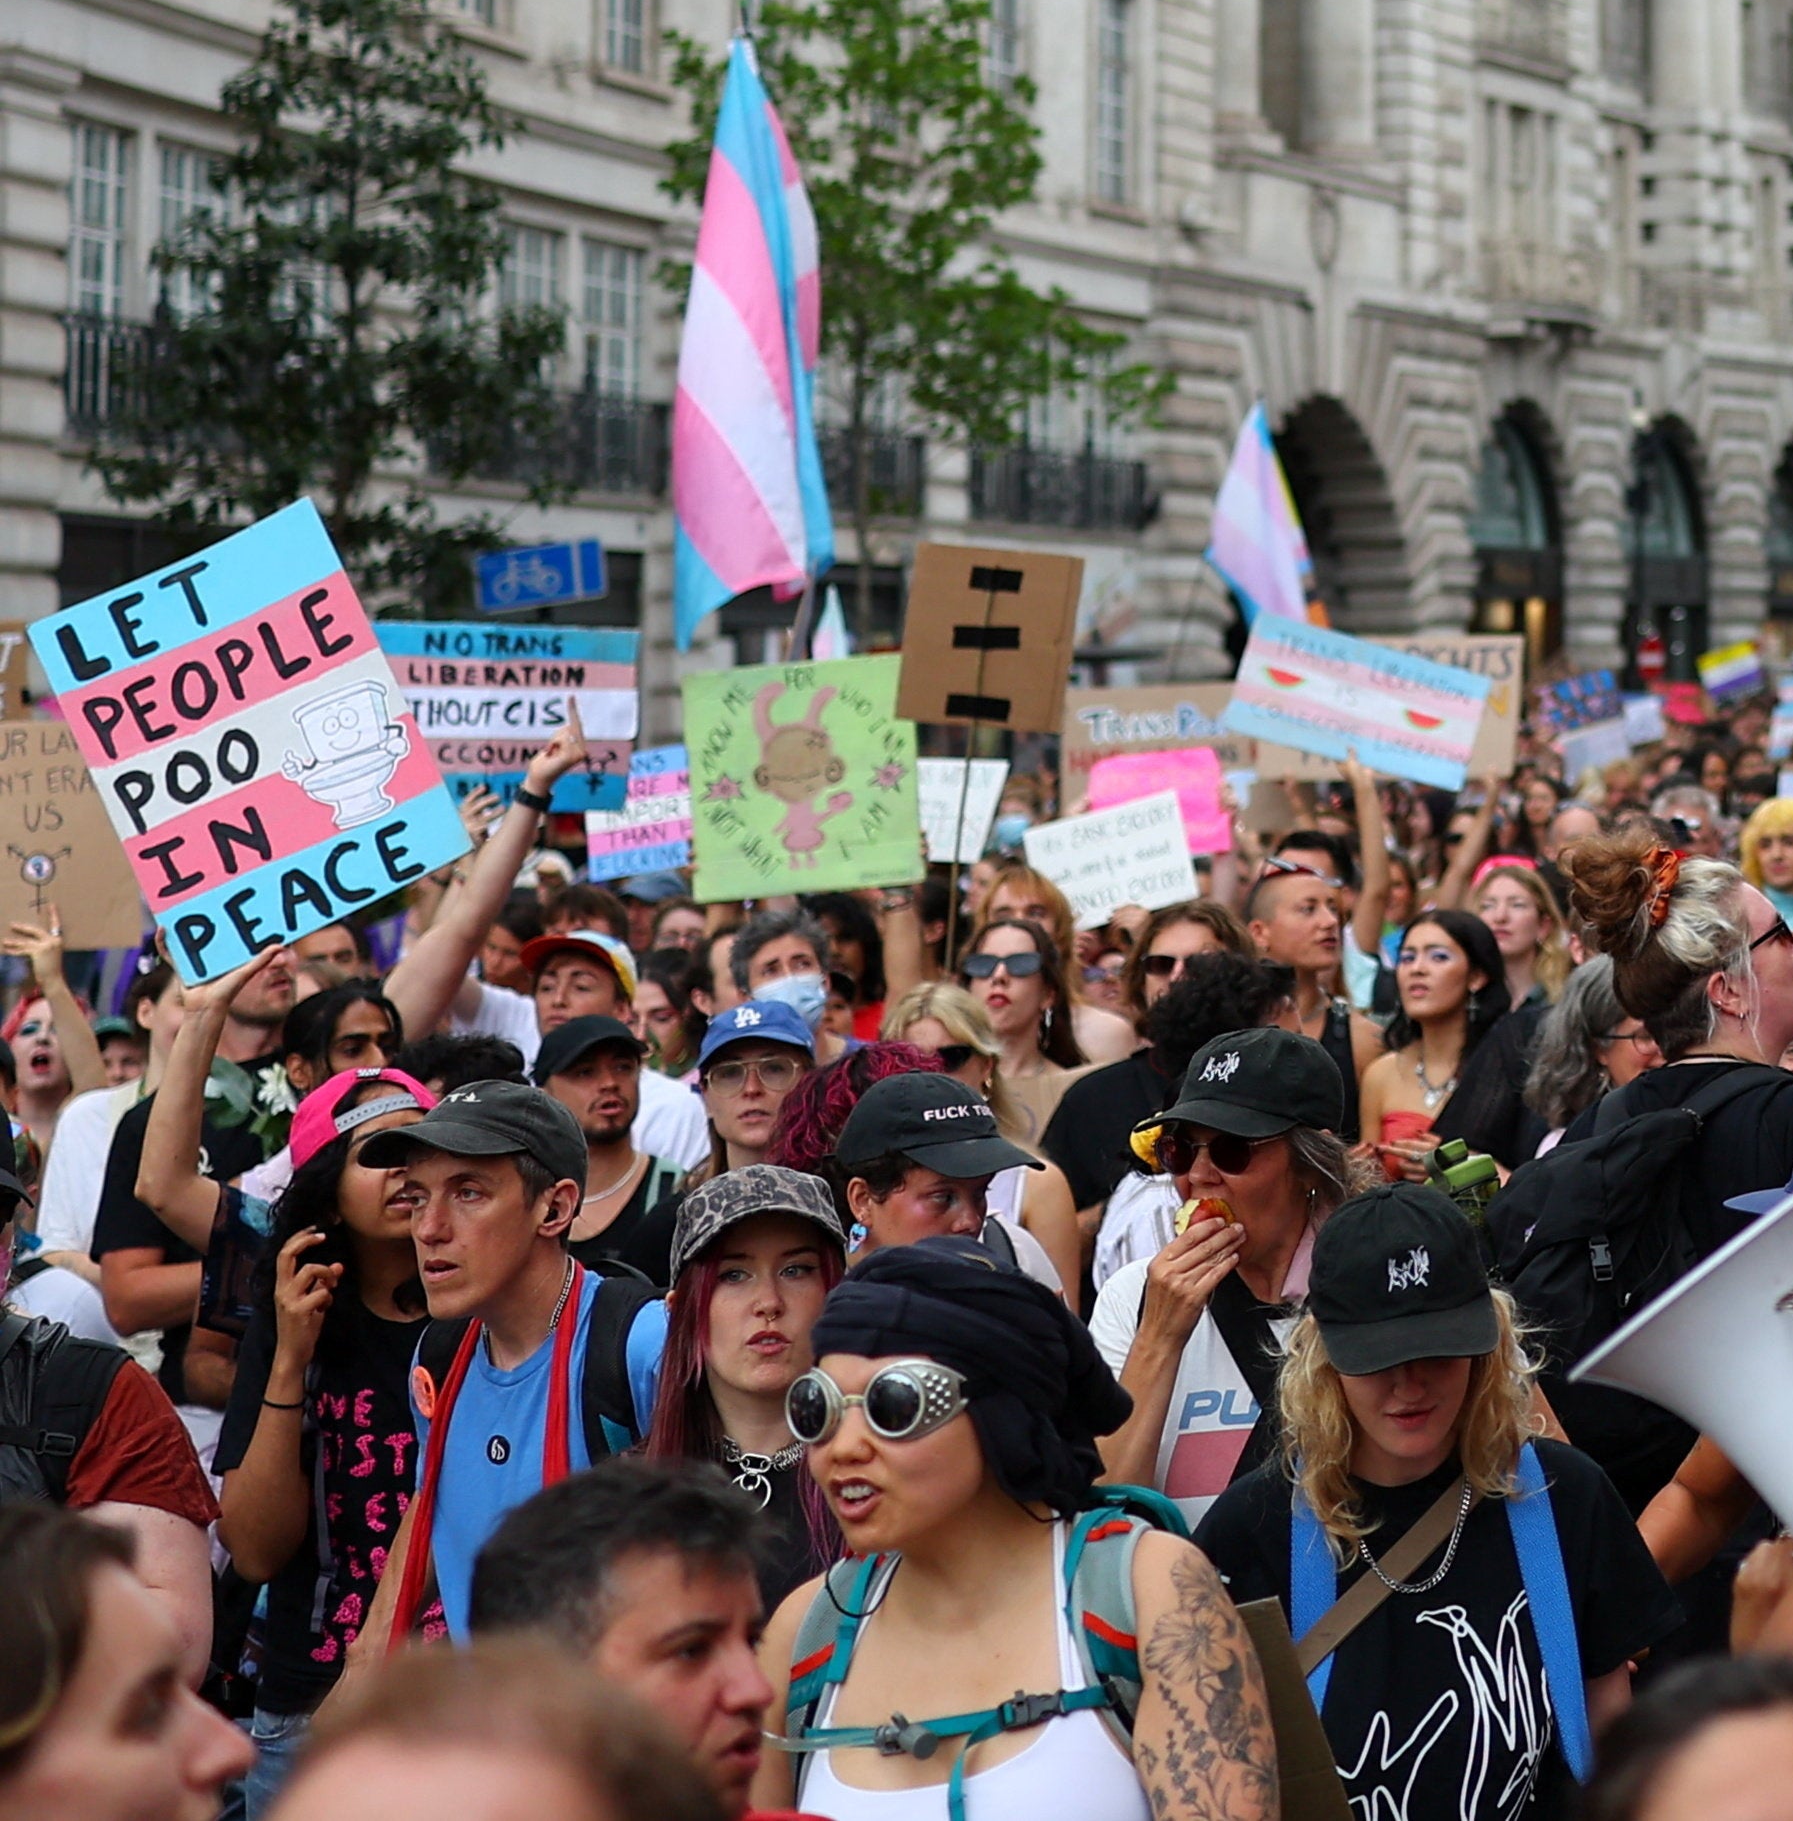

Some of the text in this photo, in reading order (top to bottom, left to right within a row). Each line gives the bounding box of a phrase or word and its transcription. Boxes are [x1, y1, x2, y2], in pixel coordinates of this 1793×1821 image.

[56, 561, 210, 681] LET
[424, 632, 563, 656] NO TRANS
[82, 588, 354, 760] PEOPLE
[408, 663, 585, 687] LIBERATION
[784, 668, 814, 689] FOR
[503, 698, 566, 725] CIS
[112, 728, 260, 835] POO
[24, 801, 64, 833] US
[861, 802, 889, 838] AM
[139, 806, 273, 899] IN
[174, 820, 426, 978] PEACE
[923, 1105, 970, 1121] FUCK
